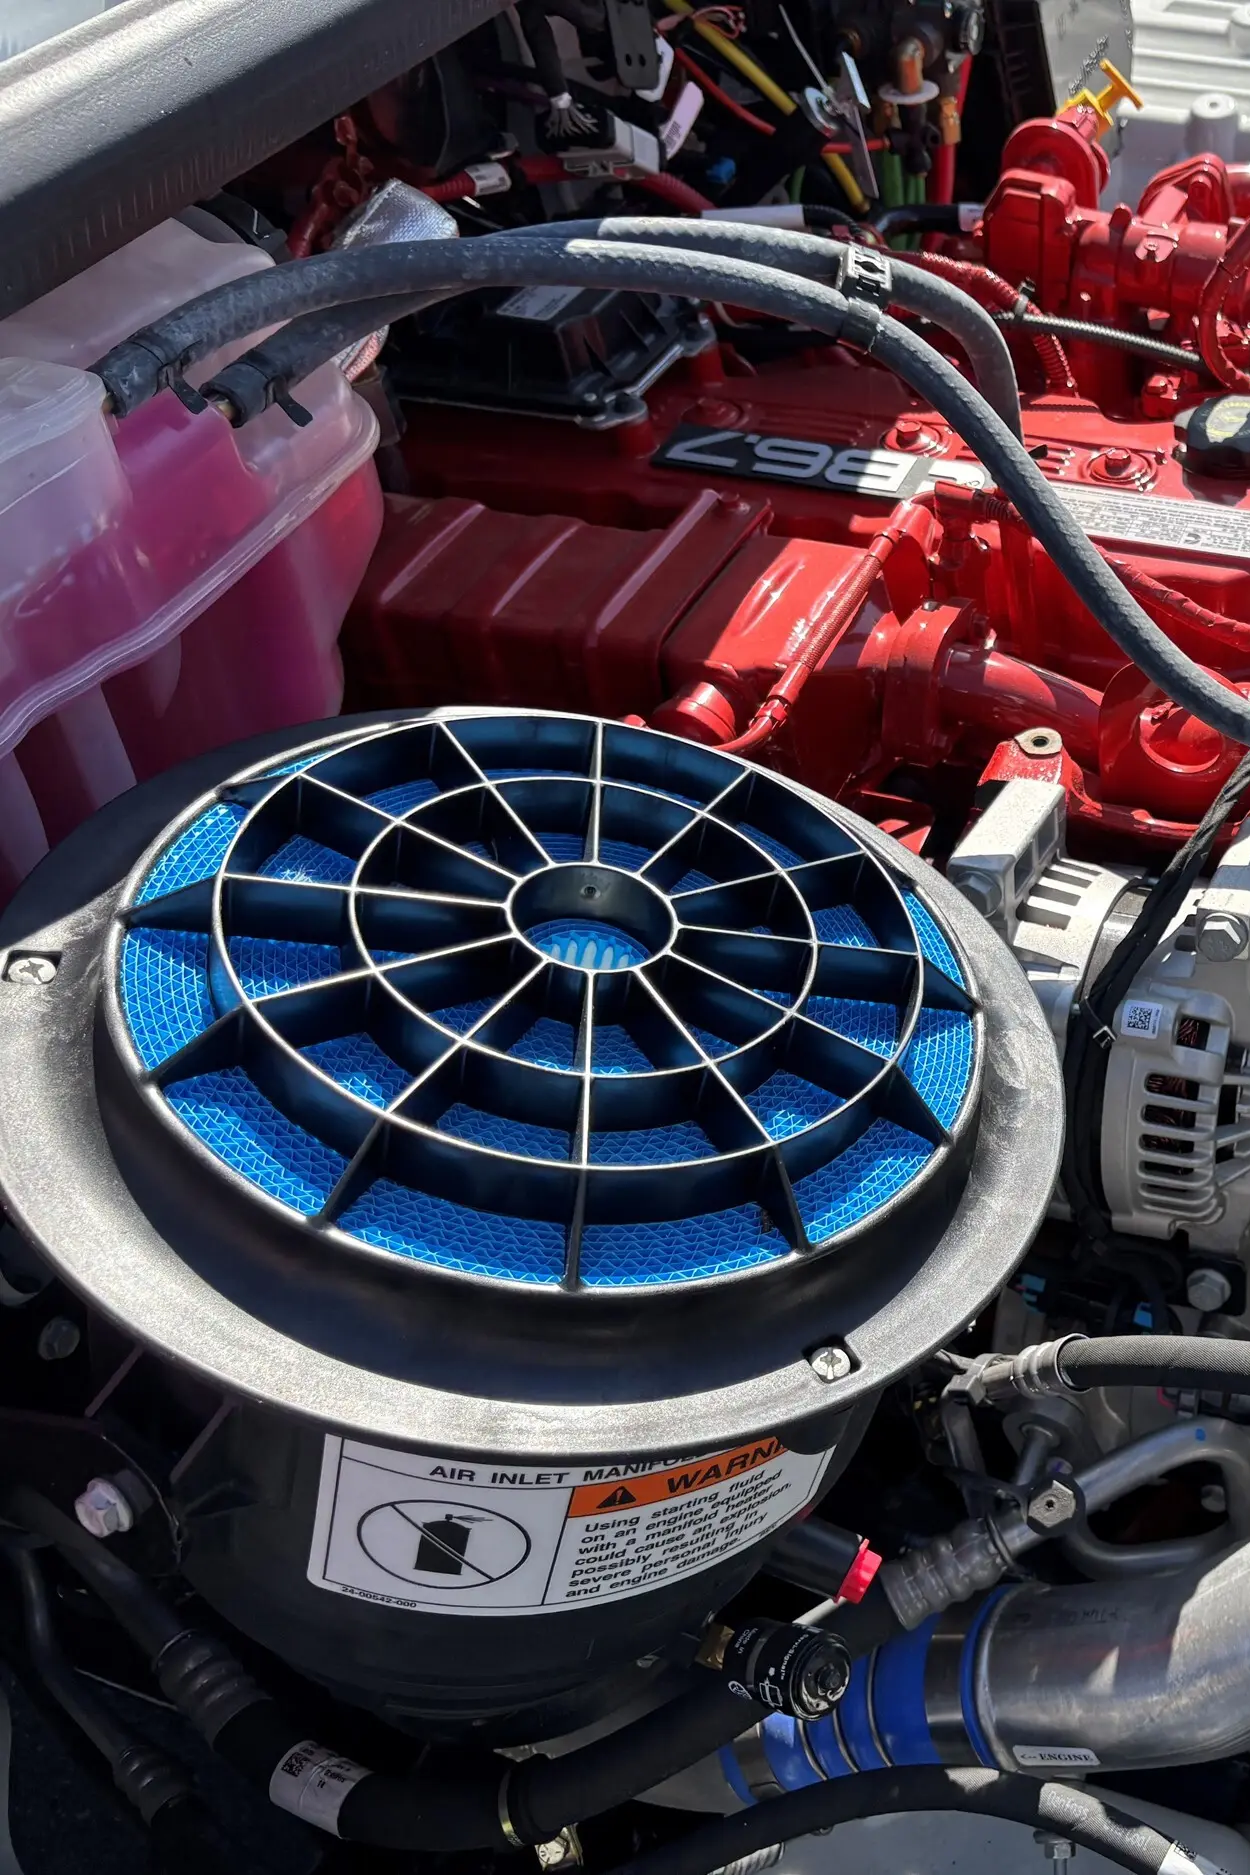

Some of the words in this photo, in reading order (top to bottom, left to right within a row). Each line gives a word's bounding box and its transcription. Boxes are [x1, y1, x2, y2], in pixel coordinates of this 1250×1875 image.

[665, 431, 918, 493] B6.7
[429, 1465, 476, 1482] AIR
[491, 1471, 570, 1485] INLET
[582, 1455, 697, 1482] MANIFO
[667, 1439, 782, 1493] WARN
[574, 1548, 627, 1566] could
[634, 1533, 686, 1554] cause
[692, 1523, 713, 1536] an
[720, 1482, 792, 1525] explosion.
[578, 1541, 617, 1555] with
[625, 1538, 636, 1546] a
[645, 1509, 719, 1541] manifold
[725, 1484, 773, 1513] heater
[581, 1534, 605, 1544] on
[614, 1527, 637, 1538] an
[645, 1507, 704, 1531] engine
[711, 1468, 783, 1510] equipped
[585, 1516, 641, 1533] Using
[651, 1491, 719, 1519] starting
[729, 1469, 766, 1493] fluid
[565, 1584, 601, 1598] and
[609, 1567, 668, 1589] engine
[676, 1537, 741, 1569] damage.
[568, 1569, 632, 1587] severe
[641, 1539, 716, 1573] personal
[724, 1512, 768, 1540] injury
[571, 1553, 652, 1579] possibly
[662, 1521, 736, 1556] resulting
[744, 1510, 758, 1521] in
[341, 1586, 417, 1608] 24-00542-000
[1039, 1753, 1093, 1762] ENGINE
